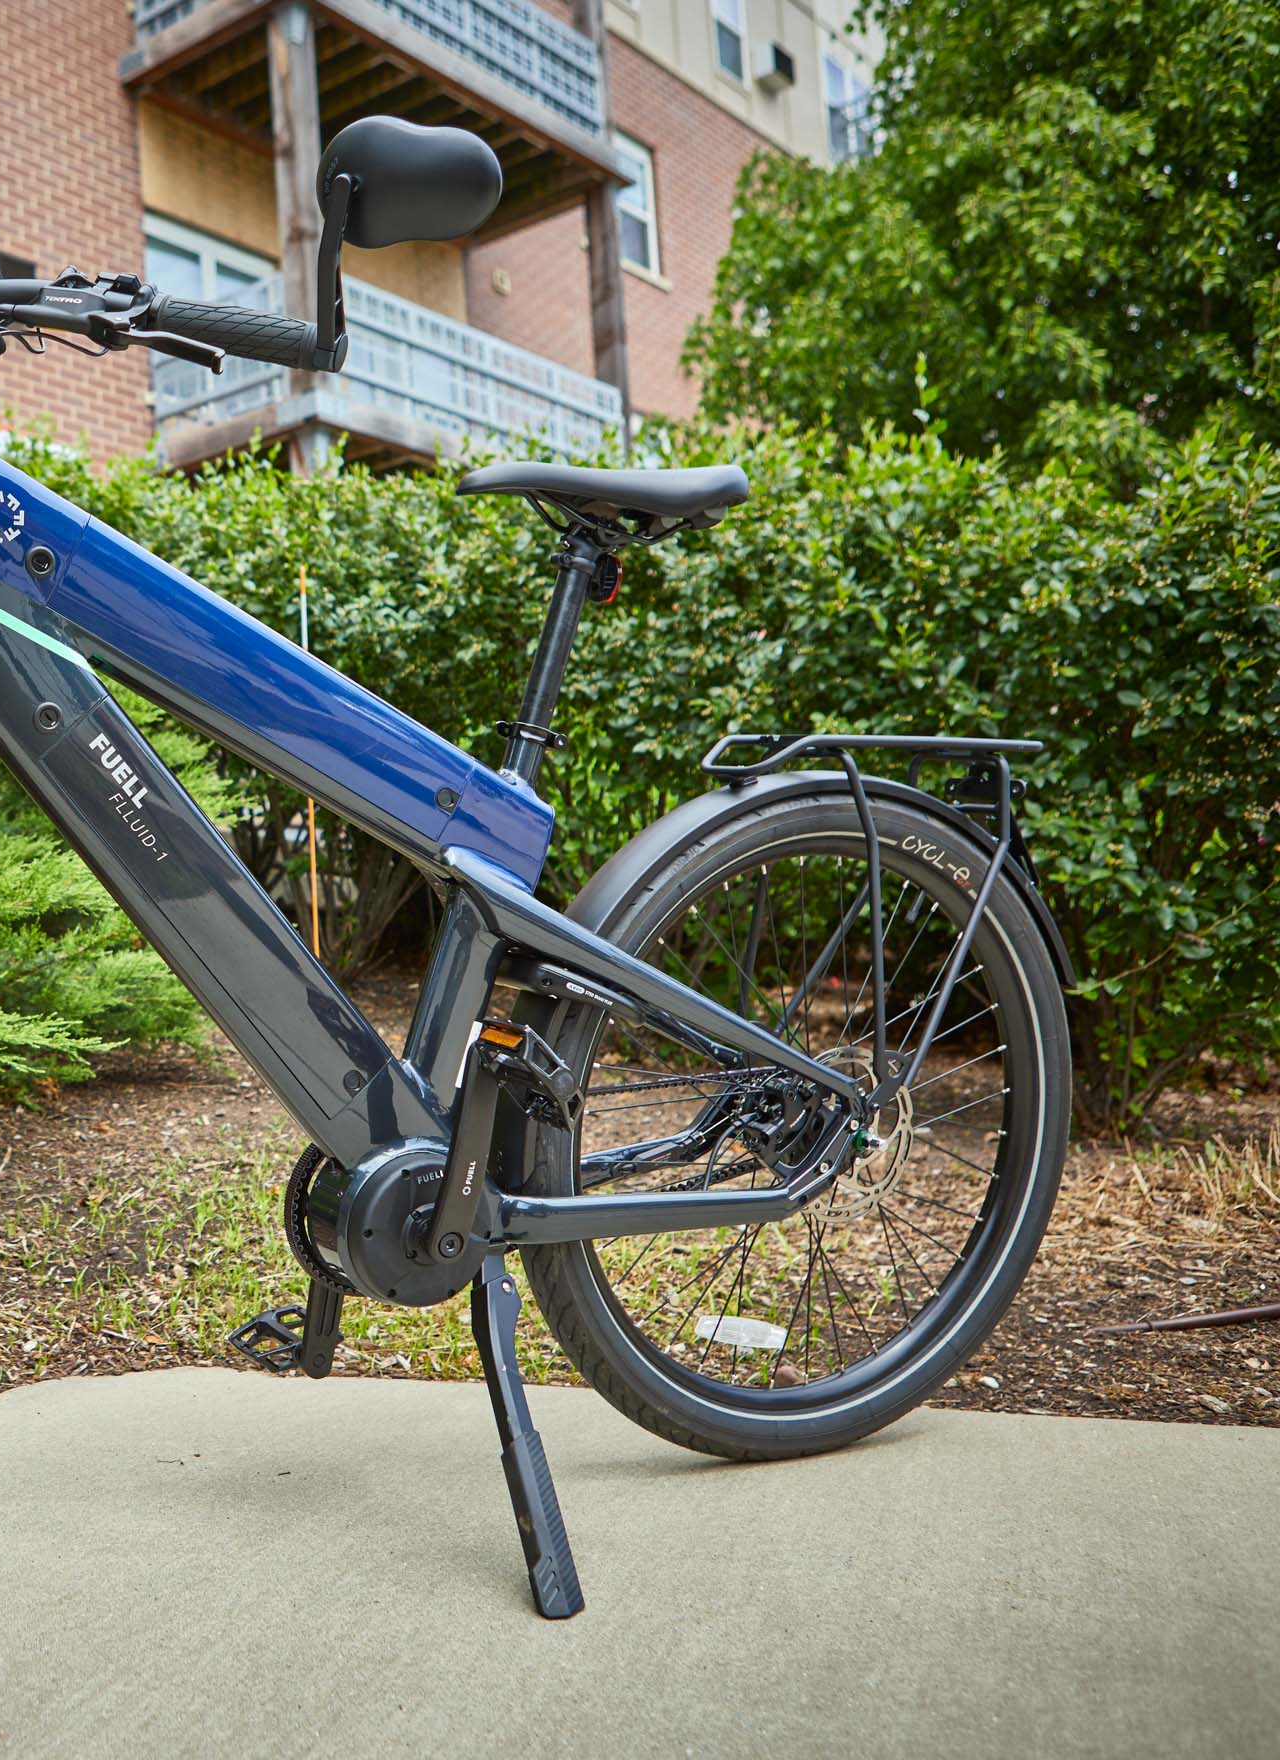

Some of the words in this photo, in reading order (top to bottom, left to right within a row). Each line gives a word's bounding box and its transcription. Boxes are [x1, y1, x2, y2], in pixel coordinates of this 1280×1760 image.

[44, 295, 83, 304] TEKTRO
[88, 732, 149, 810] FUELL
[108, 792, 169, 862] FLLUID-1
[901, 835, 970, 881] CYCL-e
[465, 1160, 476, 1185] FUELL
